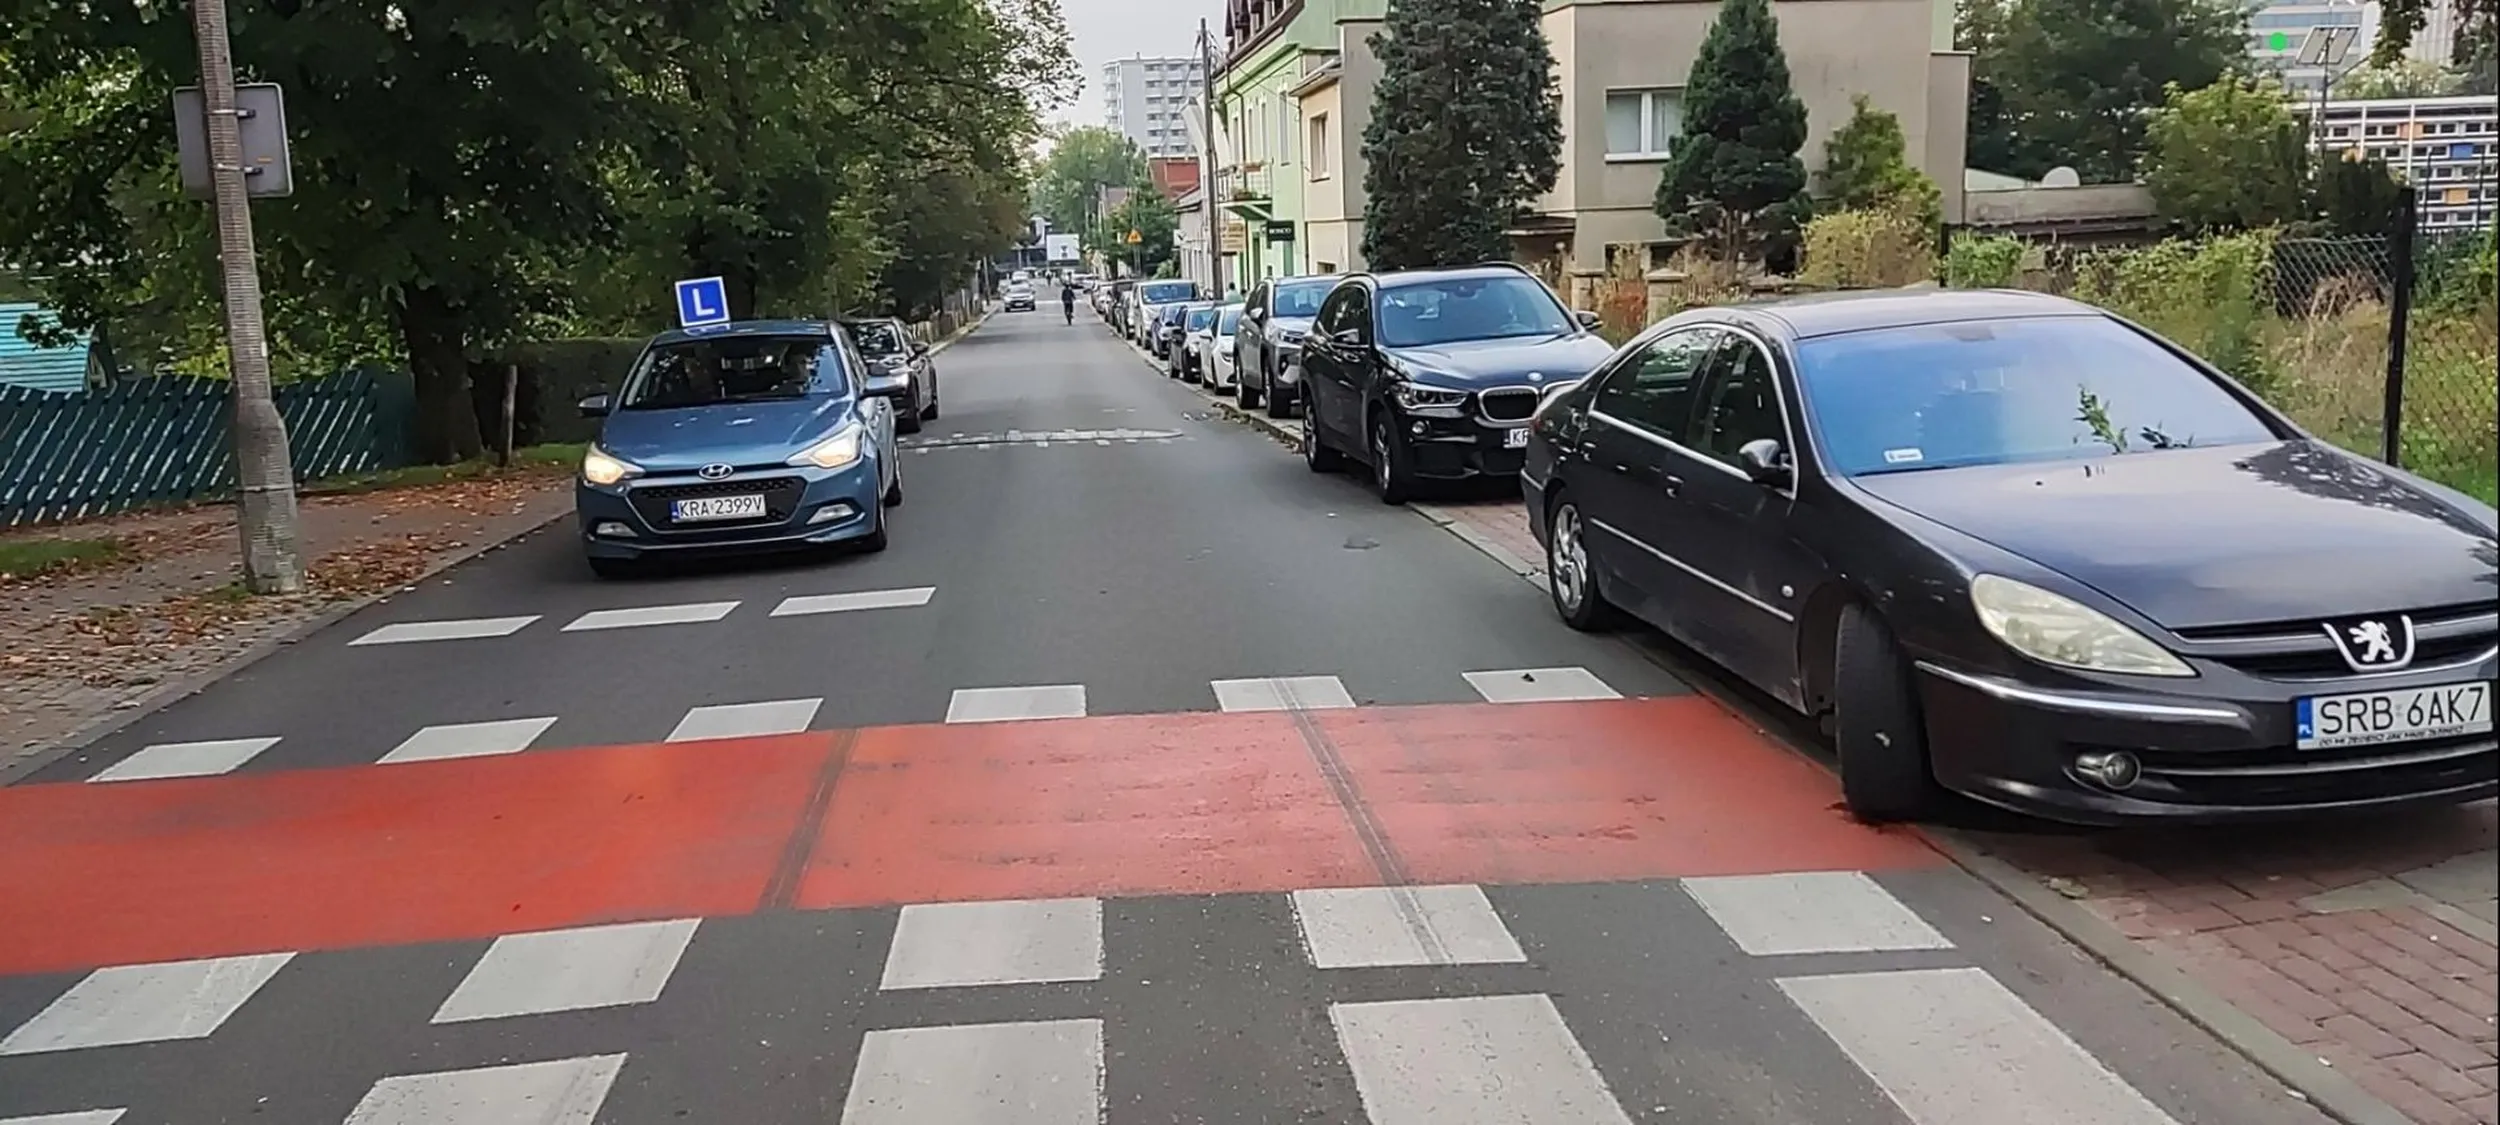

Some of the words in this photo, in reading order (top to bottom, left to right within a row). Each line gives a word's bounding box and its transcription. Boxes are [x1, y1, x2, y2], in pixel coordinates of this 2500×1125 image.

[692, 288, 716, 317] L
[680, 501, 709, 517] KRA
[714, 497, 763, 515] 2399V
[2320, 696, 2394, 735] SRB
[2406, 686, 2485, 727] 6AK7
